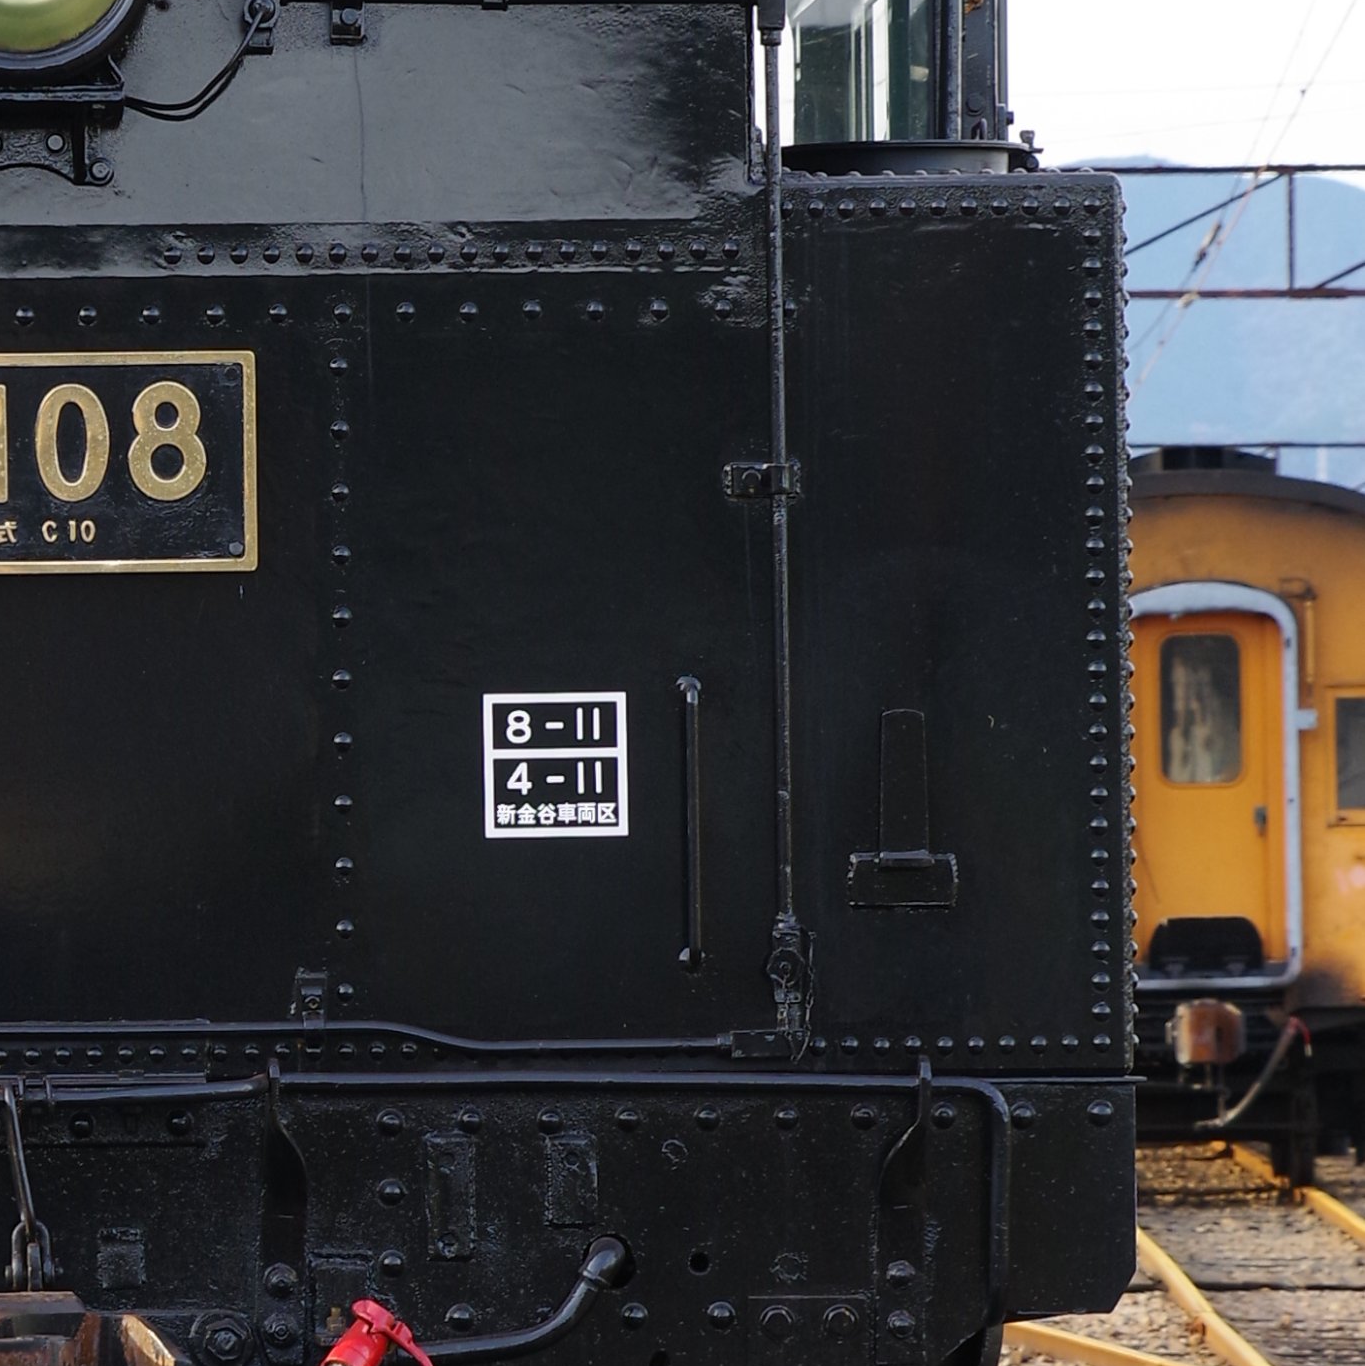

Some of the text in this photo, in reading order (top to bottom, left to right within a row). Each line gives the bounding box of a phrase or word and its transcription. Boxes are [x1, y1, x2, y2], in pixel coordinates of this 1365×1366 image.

[506, 707, 600, 744] 8-11
[506, 761, 602, 796] 4-11
[496, 802, 617, 825] 新金谷車両区
